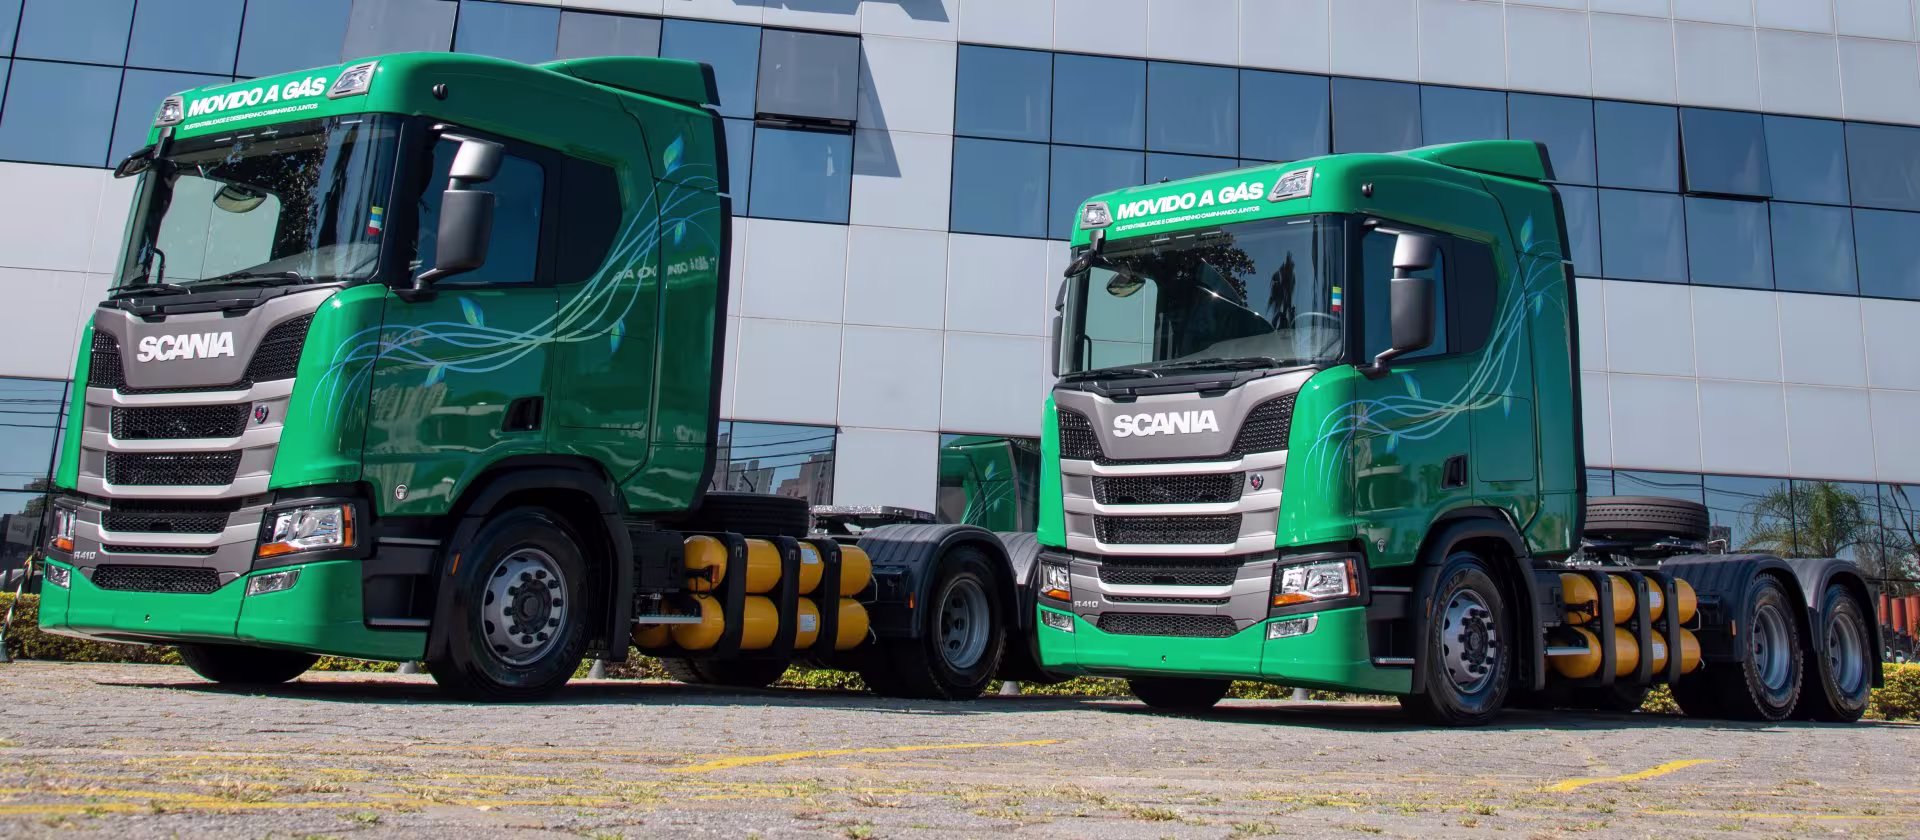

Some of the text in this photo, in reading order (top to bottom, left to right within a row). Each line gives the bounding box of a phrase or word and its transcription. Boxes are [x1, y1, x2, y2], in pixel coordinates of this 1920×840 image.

[187, 76, 327, 118] MOVIDO A GÁS
[297, 103, 318, 111] JUNTOS
[1116, 182, 1264, 220] MOVIDO A GÁS
[1200, 208, 1237, 219] CAMINHANDO
[1237, 205, 1260, 214] JUNTOS
[137, 331, 235, 362] SCANIA
[1112, 409, 1219, 437] SCANIA
